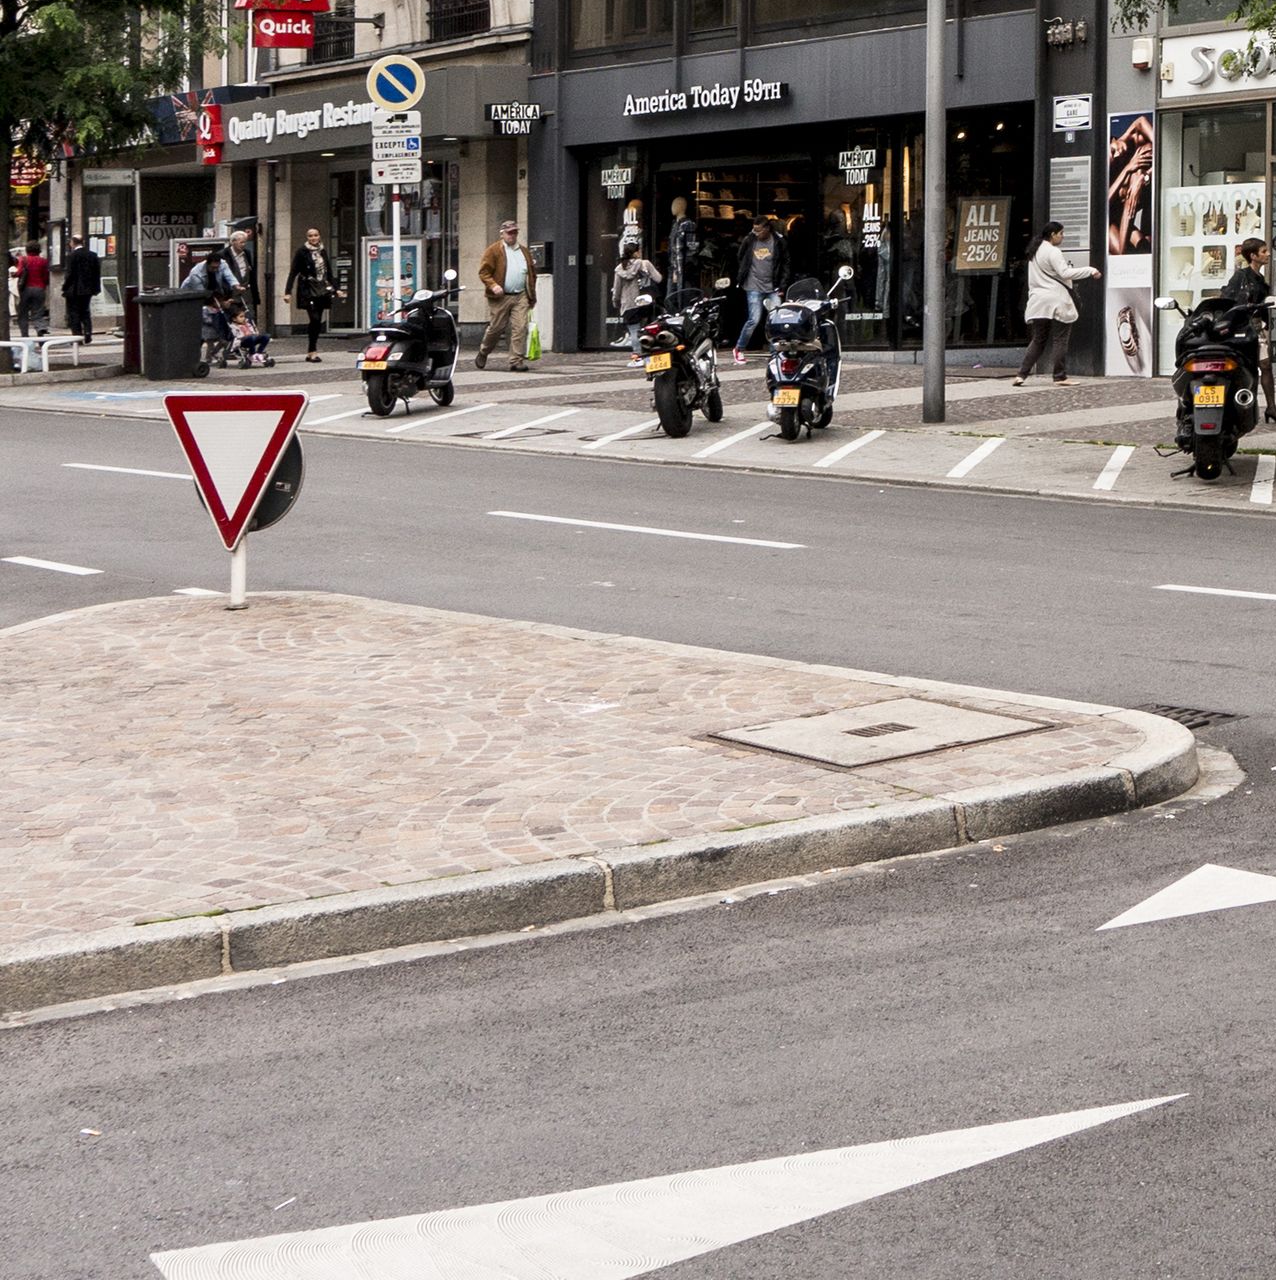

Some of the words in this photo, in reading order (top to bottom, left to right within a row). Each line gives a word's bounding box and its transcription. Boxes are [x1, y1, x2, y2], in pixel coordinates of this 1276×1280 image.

[259, 19, 312, 36] Quick
[623, 90, 687, 116] America
[691, 84, 740, 109] Today
[744, 78, 781, 102] 59TH
[492, 105, 539, 119] AMERICA
[229, 112, 275, 145] Quality
[276, 109, 322, 138] Burger
[323, 100, 378, 129] Restau
[500, 121, 531, 135] TODAY
[839, 151, 876, 169] AMERICA
[601, 169, 631, 185] AMERICA
[845, 168, 869, 185] TODAY
[1165, 189, 1260, 217] PROMOS
[142, 214, 168, 224] OUÉ
[171, 215, 194, 224] PAR
[863, 203, 881, 221] ALL
[966, 204, 1000, 227] ALL
[862, 222, 881, 233] JEANS
[964, 229, 999, 242] JEANS
[961, 245, 998, 262] -25%
[1199, 395, 1220, 403] 0911
[1204, 387, 1216, 395] LS
